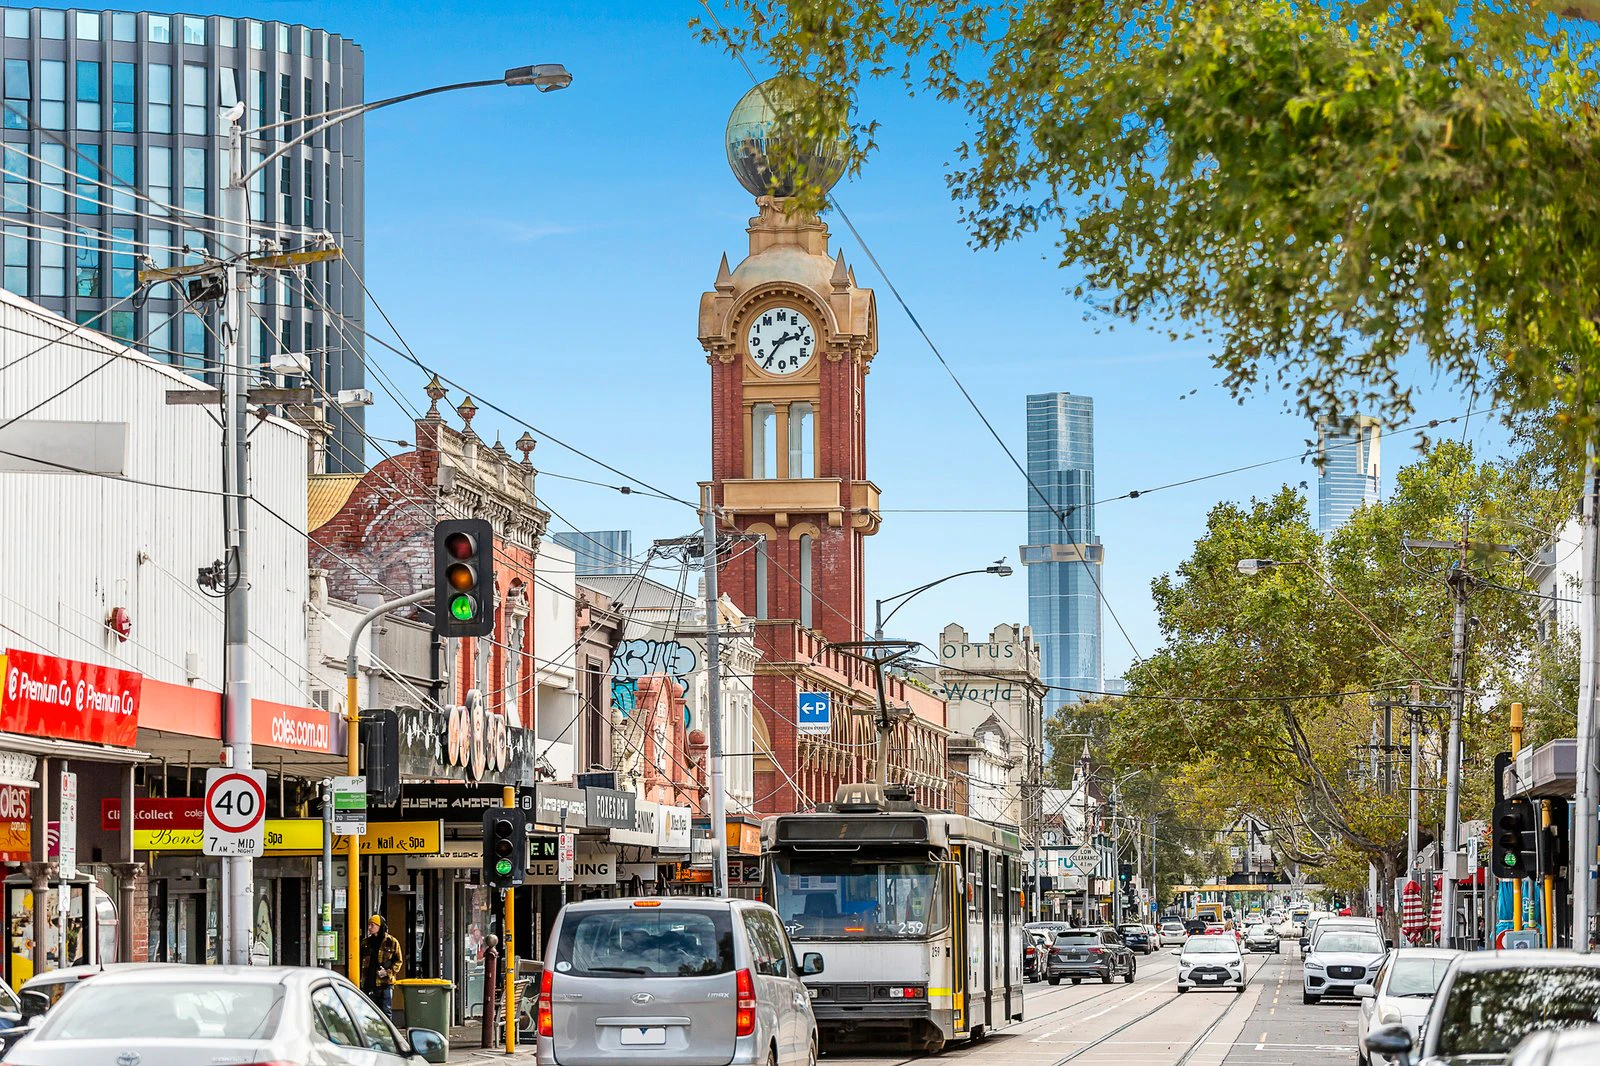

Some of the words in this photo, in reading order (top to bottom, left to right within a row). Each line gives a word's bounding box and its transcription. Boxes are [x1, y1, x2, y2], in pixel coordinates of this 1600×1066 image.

[943, 644, 1013, 658] OPTUS
[20, 672, 57, 704] Premium
[59, 679, 72, 706] Co
[86, 684, 120, 714] Premium
[121, 690, 134, 715] Co
[943, 682, 1012, 701] World
[815, 702, 826, 715] P
[271, 711, 328, 748] coles.com.au
[0, 785, 26, 818] oles
[215, 790, 254, 816] 40
[401, 797, 448, 808] SUSHI
[596, 795, 616, 819] FOXES
[107, 810, 173, 820] Cli&Collect
[356, 826, 365, 834] 10
[237, 838, 255, 848] MID
[268, 831, 282, 845] Spa
[378, 836, 394, 848] Nail
[396, 840, 408, 851] &
[409, 836, 424, 848] Spa
[898, 921, 924, 934] 259
[931, 946, 940, 957] 259
